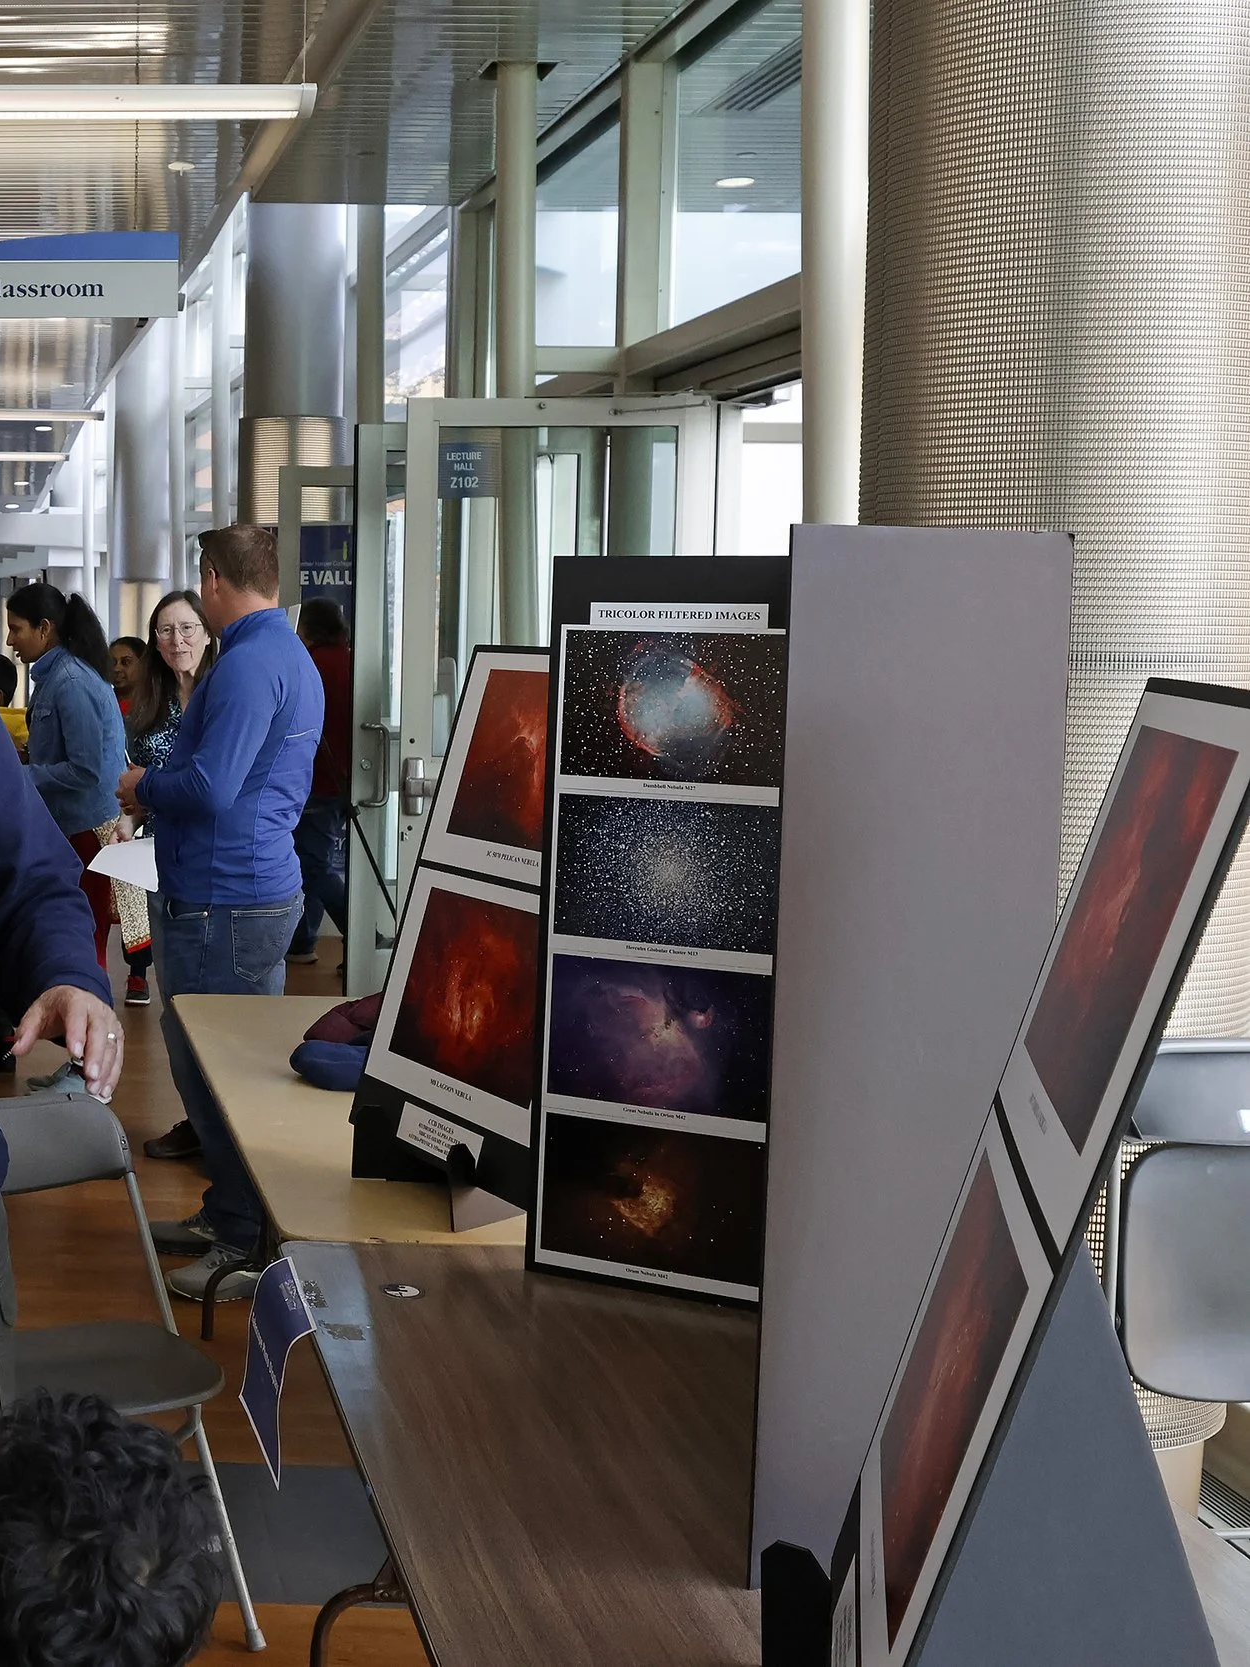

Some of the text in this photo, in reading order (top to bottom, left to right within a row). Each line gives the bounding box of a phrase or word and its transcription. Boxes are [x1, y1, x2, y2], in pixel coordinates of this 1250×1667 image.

[446, 451, 482, 461] LECTURE
[453, 462, 474, 471] HALL
[450, 476, 479, 488] Z102
[598, 609, 761, 621] TRICOLOR FILTERED IMAGES
[521, 855, 539, 867] NEBULA
[436, 1081, 454, 1093] LAGOON
[454, 1088, 472, 1101] NEBULA
[438, 1122, 454, 1134] IMAGES
[640, 1270, 657, 1278] Nebula
